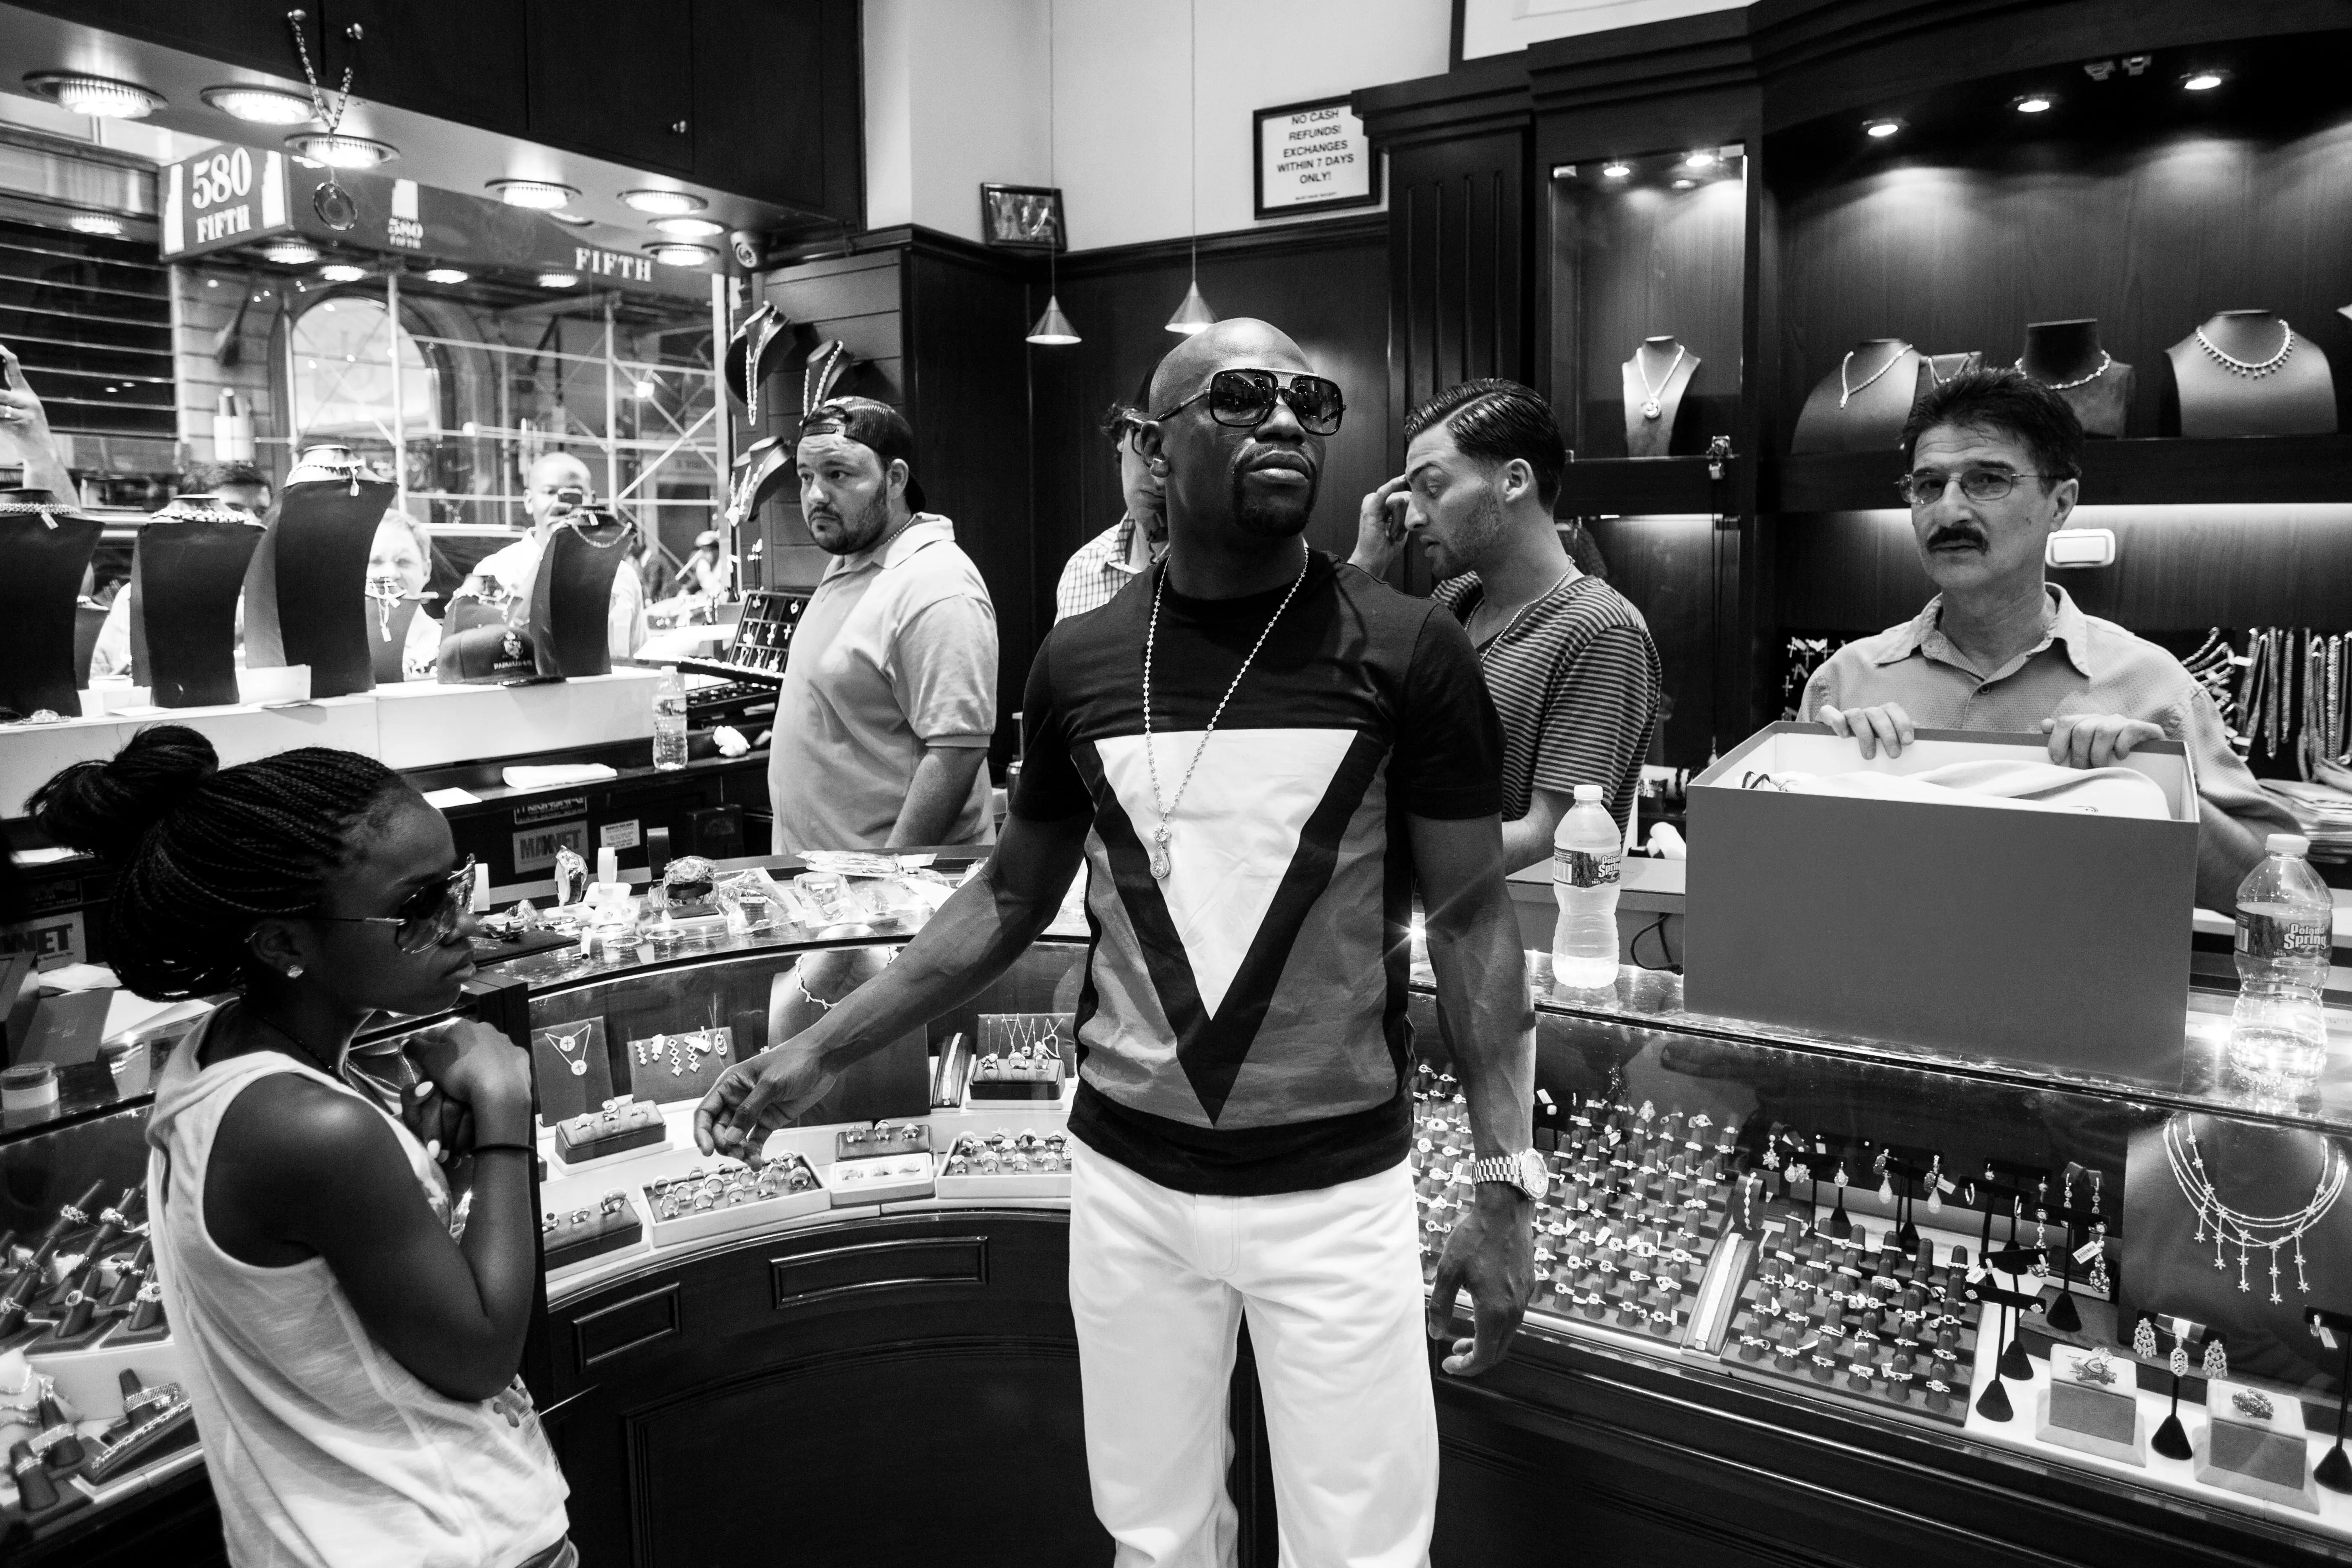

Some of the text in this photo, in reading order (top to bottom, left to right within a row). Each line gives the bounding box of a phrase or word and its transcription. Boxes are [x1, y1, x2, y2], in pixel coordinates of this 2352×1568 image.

[1292, 108, 1339, 125] NO CASH
[1289, 125, 1341, 140] REFUNDS!
[1283, 140, 1348, 157] EXCHANGES
[1277, 153, 1354, 172] WITHIN 7 DAYS
[192, 147, 252, 209] 580
[1300, 171, 1332, 183] ONLY!
[196, 204, 251, 243] FIFTH
[575, 247, 652, 282] FIFTH
[2290, 923, 2324, 934] Poland
[2284, 933, 2326, 949] Spring
